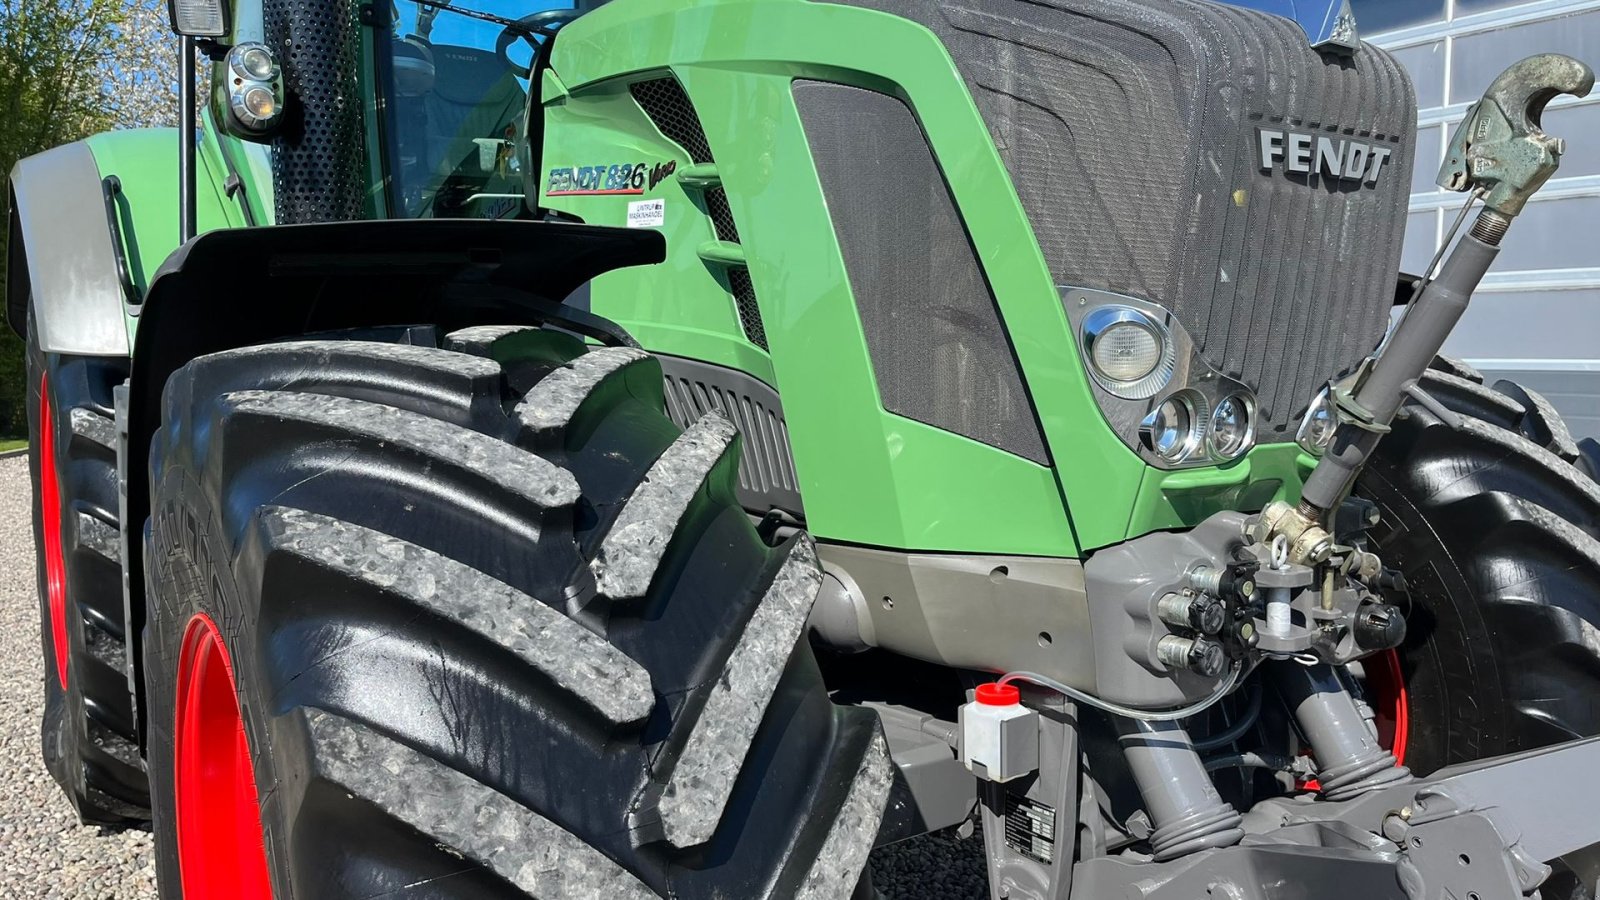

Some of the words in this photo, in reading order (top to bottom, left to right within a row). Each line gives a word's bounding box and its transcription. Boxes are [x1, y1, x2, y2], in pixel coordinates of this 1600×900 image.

[547, 165, 606, 191] FENDT
[605, 163, 647, 190] 826
[1256, 128, 1392, 184] FENDT
